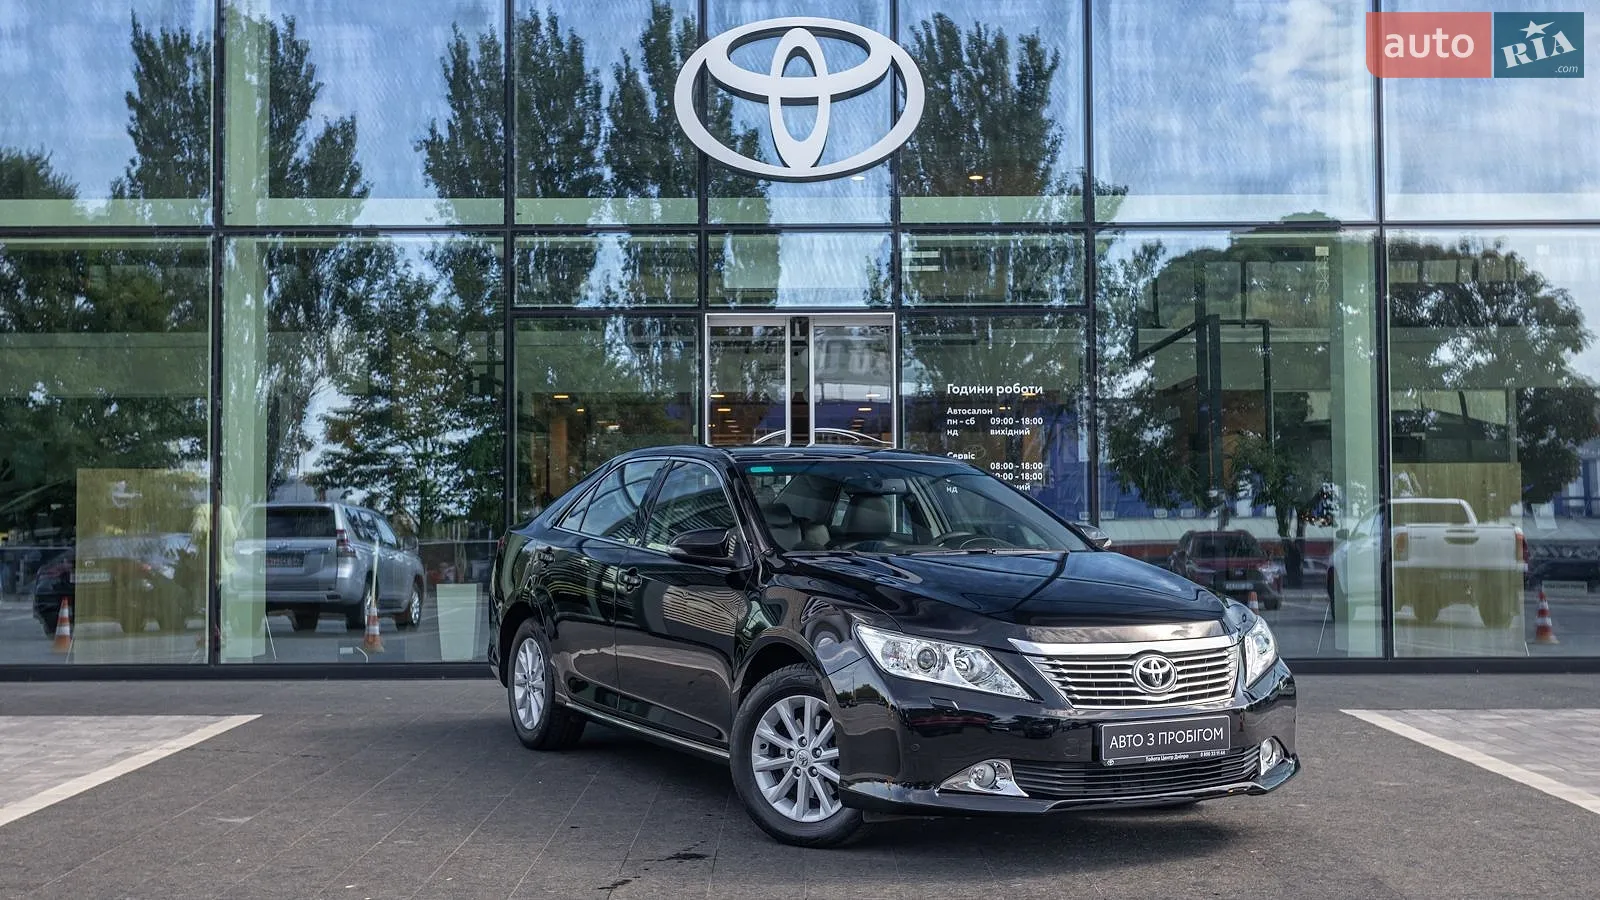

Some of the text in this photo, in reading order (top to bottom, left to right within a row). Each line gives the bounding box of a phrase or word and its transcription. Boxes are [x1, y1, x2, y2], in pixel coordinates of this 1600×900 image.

[947, 383, 1043, 396] Години роботи
[946, 407, 993, 415] Автосалон
[965, 417, 976, 425] сб
[990, 417, 1014, 425] 09:00
[1020, 417, 1044, 425] 18:00
[946, 427, 1031, 436] нд вихідний
[990, 462, 1014, 470] 08:00
[1020, 462, 1044, 470] 18:00
[991, 472, 1014, 480] :00
[1020, 472, 1044, 481] 18:00
[1109, 733, 1144, 749] АВТО
[1158, 727, 1224, 745] ПРОБІГОМ
